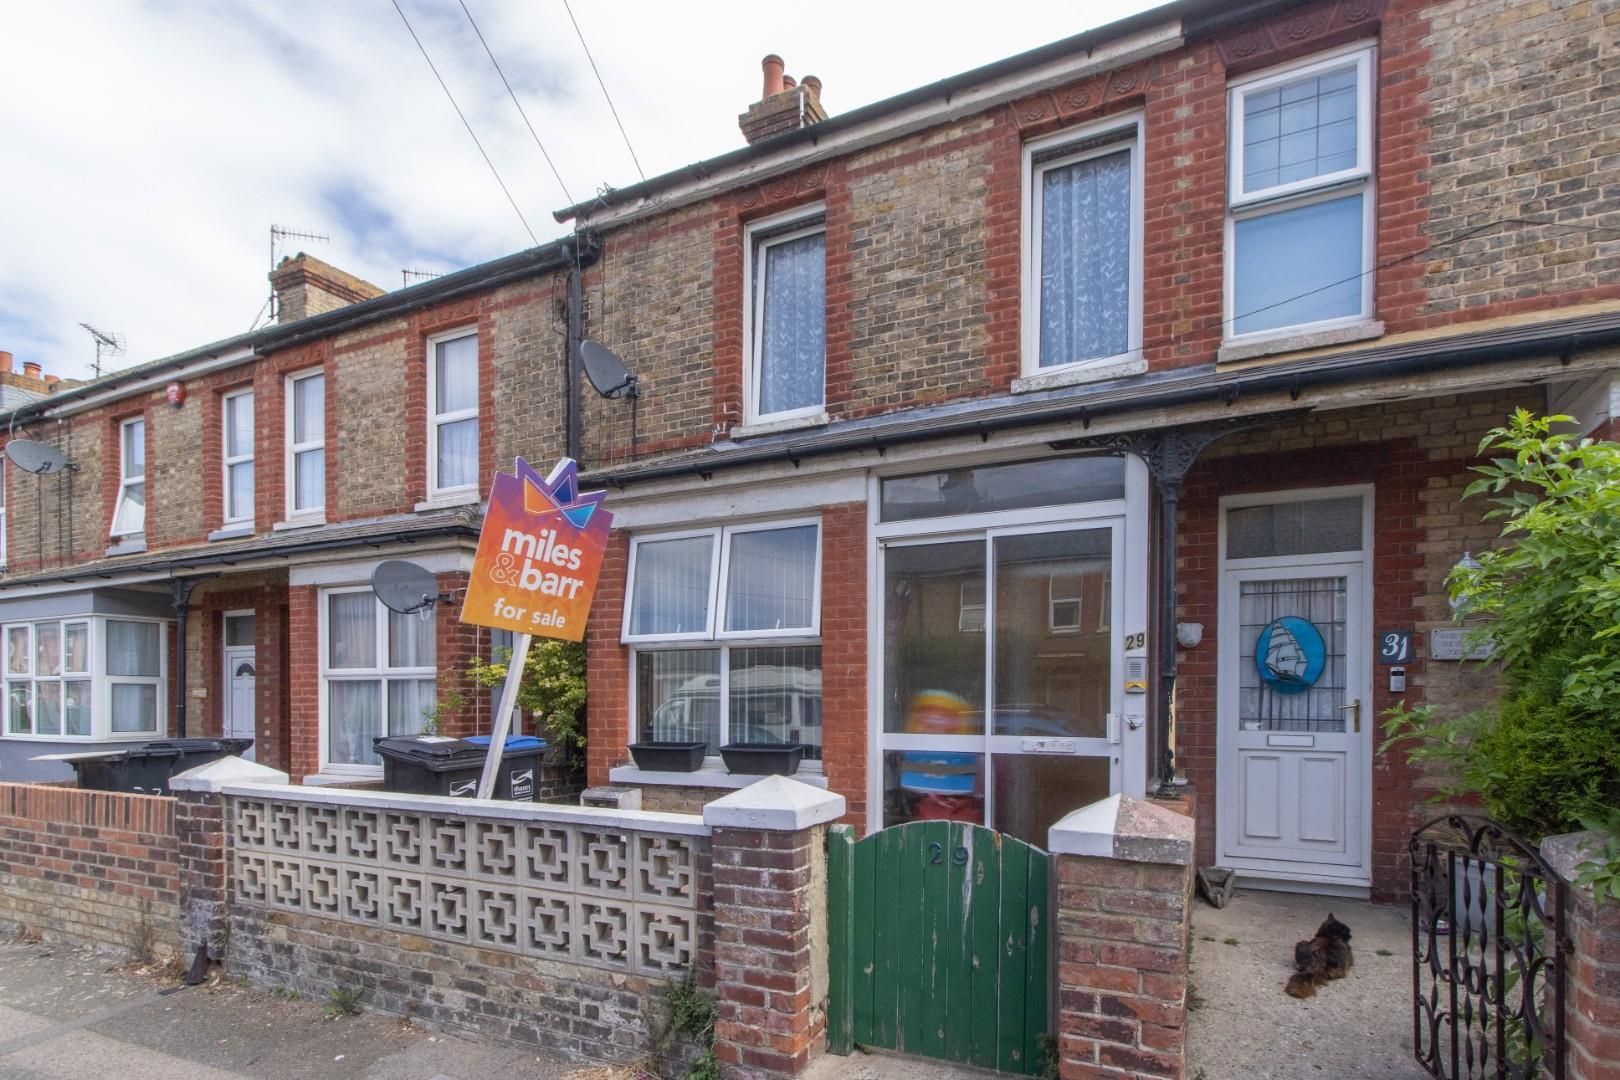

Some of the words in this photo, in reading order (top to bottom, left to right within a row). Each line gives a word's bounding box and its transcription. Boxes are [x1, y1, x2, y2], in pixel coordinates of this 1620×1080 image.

[501, 528, 583, 570] miles
[519, 558, 584, 600] barr
[494, 597, 526, 621] for
[531, 609, 566, 628] sale
[1125, 632, 1146, 651] 29
[1382, 633, 1408, 661] 31
[928, 842, 969, 866] 29
